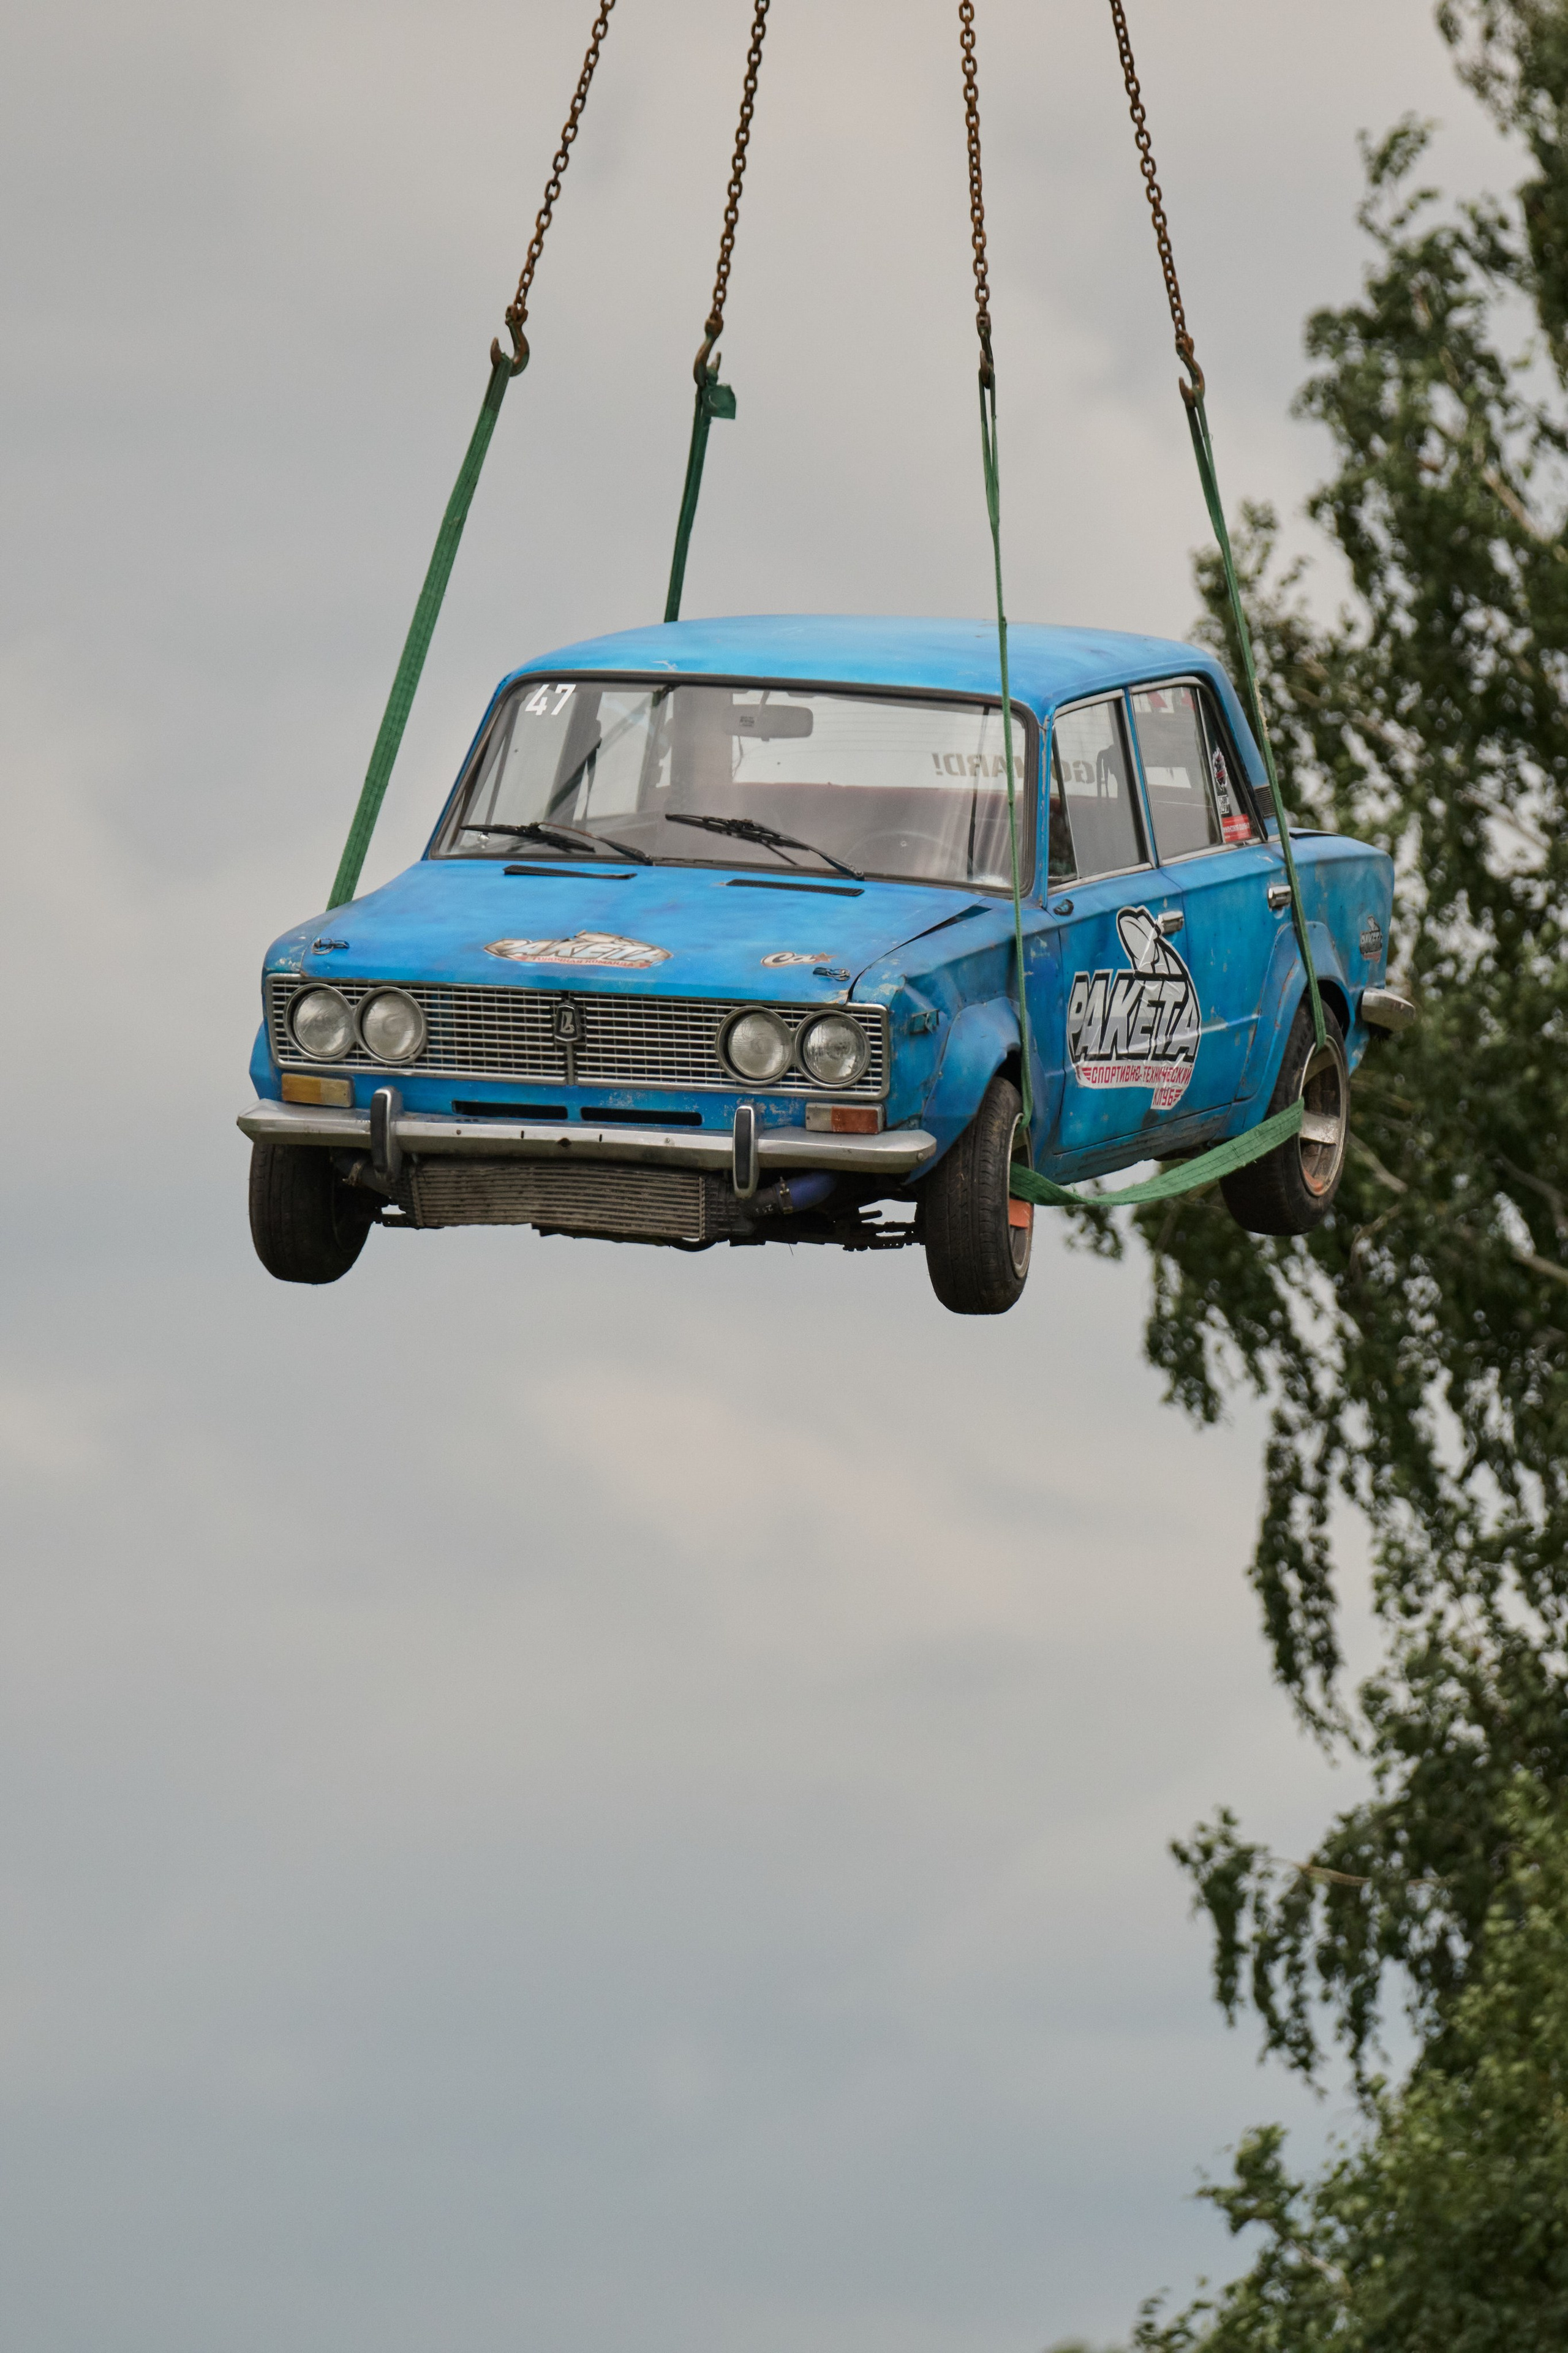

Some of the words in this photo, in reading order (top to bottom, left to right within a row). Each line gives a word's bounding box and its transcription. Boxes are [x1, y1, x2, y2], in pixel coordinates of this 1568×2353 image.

[525, 683, 576, 715] 47
[1068, 978, 1199, 1057] РАКЕТА
[1152, 1088, 1175, 1106] КЛУБ
